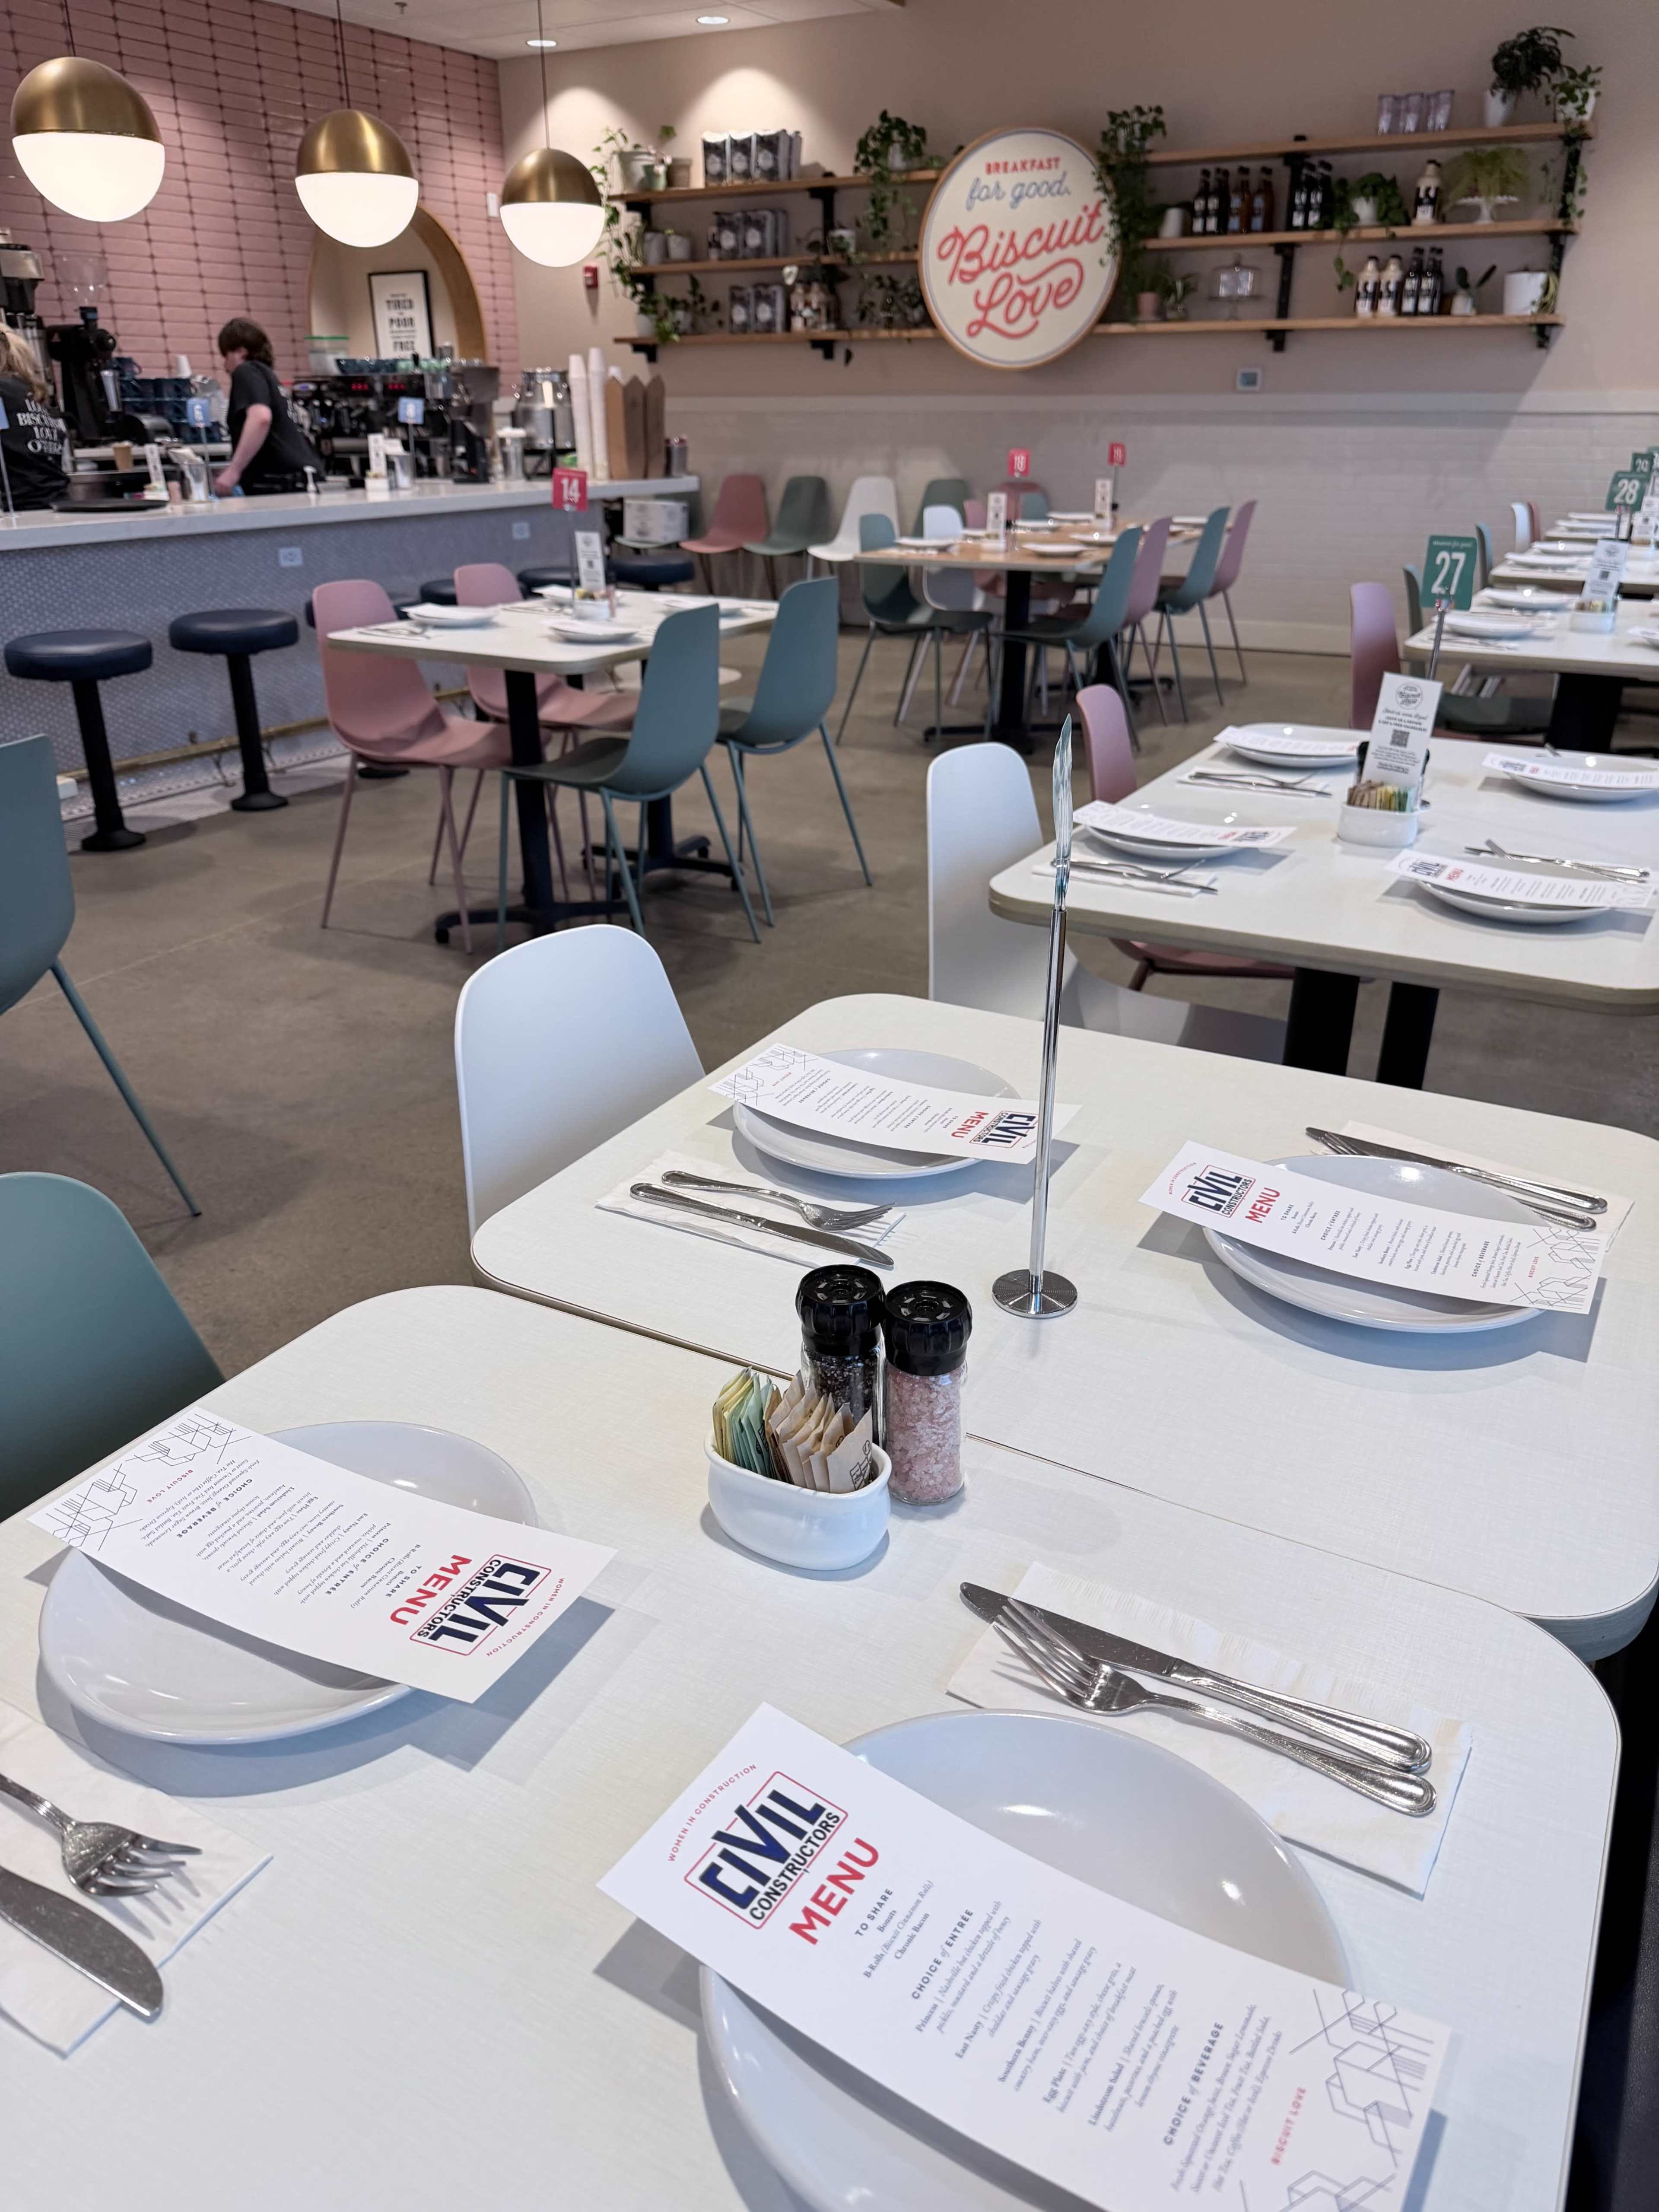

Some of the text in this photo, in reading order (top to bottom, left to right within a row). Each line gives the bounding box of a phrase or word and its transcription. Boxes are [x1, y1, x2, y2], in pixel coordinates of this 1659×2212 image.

[985, 157, 1060, 175] BREAKFAST
[966, 178, 1005, 210] for
[937, 201, 1106, 286] Biscuit
[966, 257, 1085, 340] Love
[561, 477, 581, 503] 14
[1613, 478, 1640, 505] 28
[1431, 550, 1466, 595] 27
[951, 1111, 988, 1138] MENU
[982, 1114, 1036, 1143] CIVIL
[1189, 1171, 1243, 1211] CIVIL
[1221, 1178, 1252, 1217] CONSTRUCTORS
[1245, 1187, 1280, 1223] MENU
[1283, 1204, 1294, 1215] SHARE
[1320, 1226, 1332, 1240] CHOICE
[1471, 1262, 1481, 1277] CHOICE
[1478, 1241, 1490, 1259] BEVERAGE
[1527, 1264, 1535, 1278] BISCUIT
[146, 1469, 193, 1503] BISCUIT LOVE
[223, 1479, 252, 1501] CHOICE
[256, 1486, 295, 1517] Lindstrom Salad
[176, 1507, 216, 1538] BEVERAGE
[267, 1519, 276, 1529] and
[286, 1503, 296, 1512] with
[296, 1503, 309, 1514] Plate
[248, 1504, 344, 1586] Southern Benny Biscuit halves with shaved
[270, 1547, 279, 1557] and
[360, 1538, 389, 1563] CHOICE
[217, 1560, 229, 1570] meat
[325, 1570, 354, 1595] ENTRÉE
[350, 1544, 421, 1608] B-Rolls (Biscuit Cinnamon Rolls)
[360, 1557, 395, 1588] Chronic Bacon
[385, 1570, 404, 1585] Bonuts
[385, 1566, 422, 1597] TO SHARE
[390, 1554, 472, 1625] MENU
[417, 1559, 501, 1637] CONSTRUCTORS
[429, 1563, 540, 1643] CIVIL
[548, 1578, 565, 1601] WOMEN
[486, 1611, 543, 1656] CONSTRUCTION
[667, 1764, 756, 1861] WOMEN IN CONSTRUCTION
[699, 1789, 826, 1910] CIVIL
[749, 1812, 840, 1920] CONSTRUCTORS
[788, 1837, 879, 1945] MENU
[855, 1888, 893, 1936] TO SHARE
[863, 1880, 934, 1978] B-Rolls (Biscuit Cinnamon Rolls)
[876, 1910, 896, 1932] Bonuts
[894, 1913, 929, 1959] Chronic Bacon
[911, 1910, 973, 1999] CHOICE of ENTRÉE
[915, 1900, 1001, 2032] Princess Nashville hot chicken topped with
[968, 1964, 979, 1980] and
[954, 1919, 1041, 2059] East Nasty Crispy fried chicken topped with
[1004, 1993, 1015, 2010] and
[1026, 1954, 1040, 1974] gravy
[997, 2025, 1036, 2082] Southern Benny
[1163, 2096, 1191, 2145] CHOICE
[1191, 2022, 1223, 2082] BEVERAGE
[1271, 2088, 1306, 2164] BISCUIT LOVE
